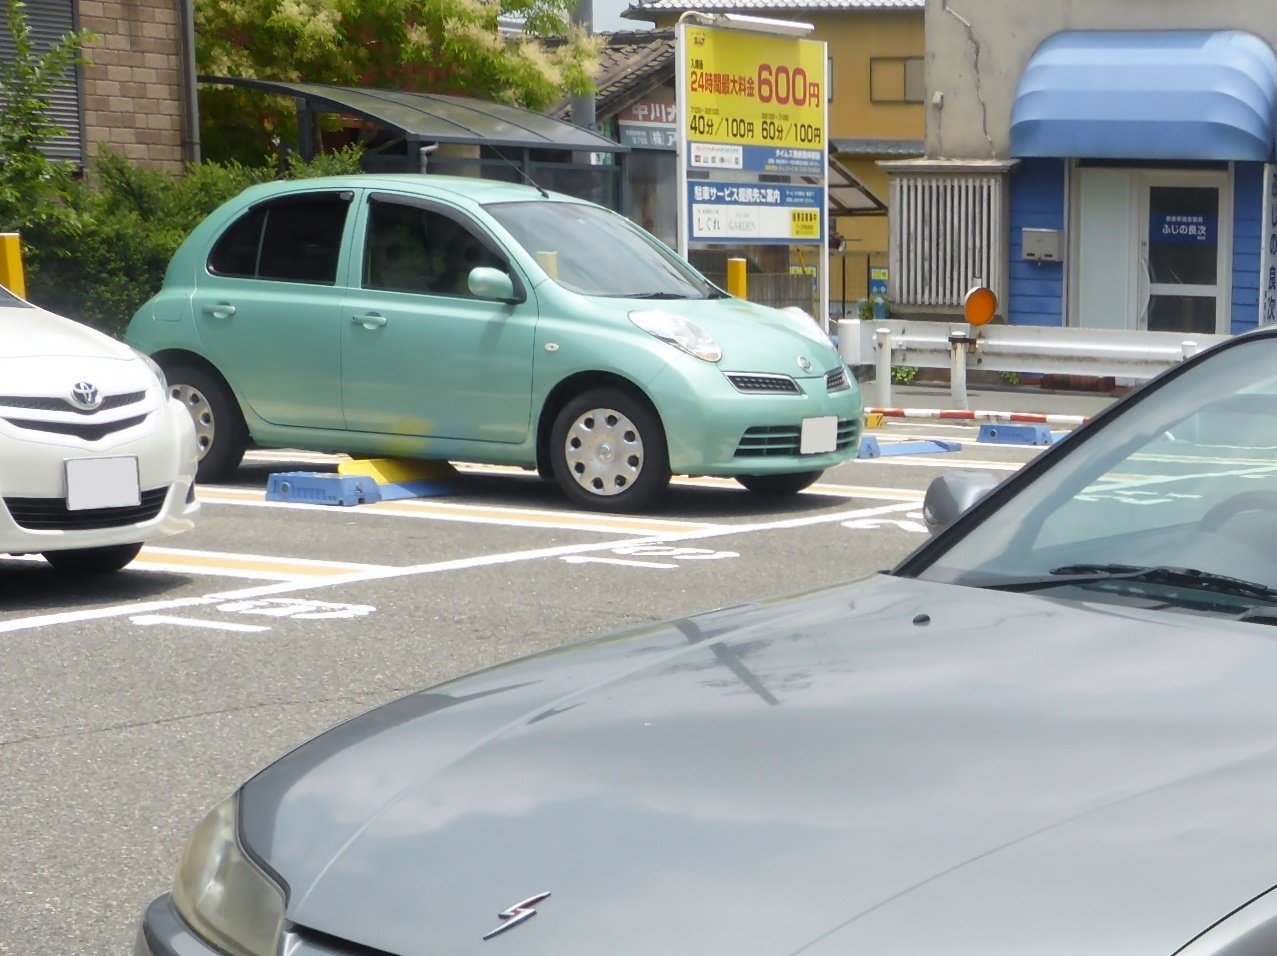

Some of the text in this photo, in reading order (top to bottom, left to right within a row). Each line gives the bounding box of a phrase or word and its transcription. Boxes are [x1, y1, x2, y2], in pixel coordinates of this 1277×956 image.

[690, 63, 820, 108] 24時間最大料金 600円
[1162, 224, 1207, 236] ふじの良次
